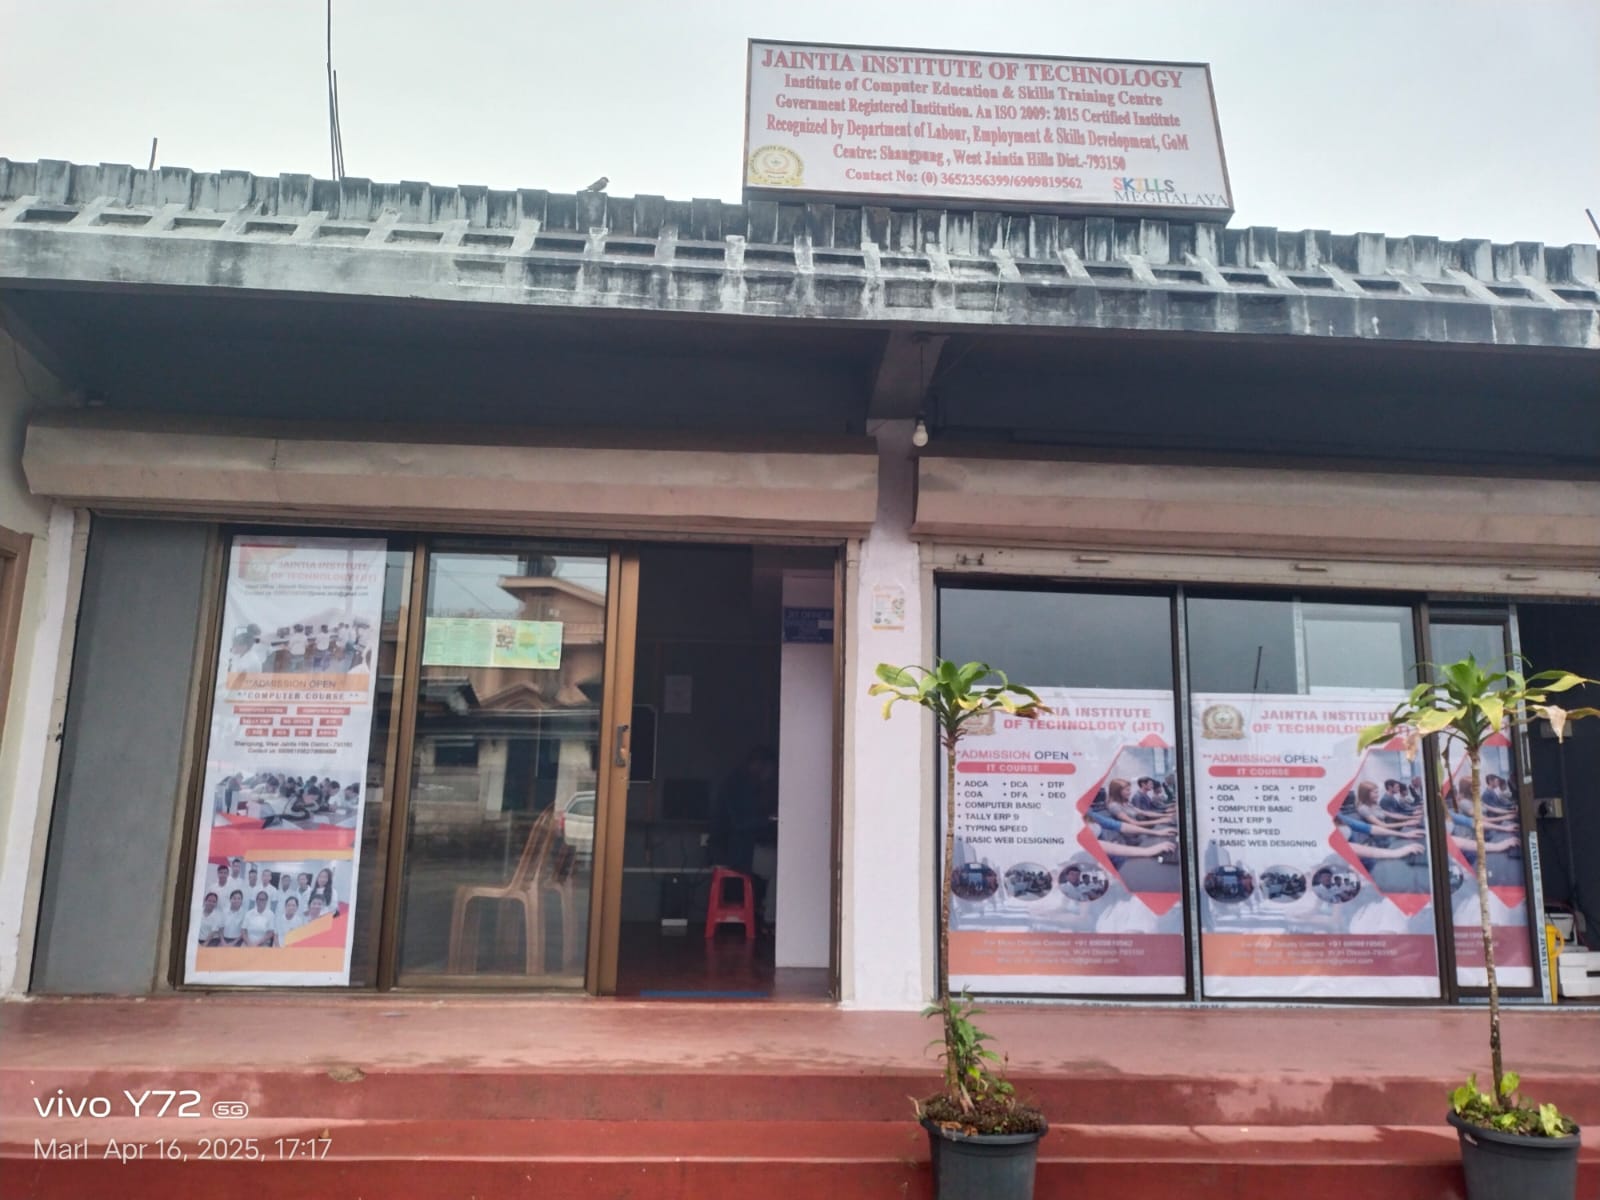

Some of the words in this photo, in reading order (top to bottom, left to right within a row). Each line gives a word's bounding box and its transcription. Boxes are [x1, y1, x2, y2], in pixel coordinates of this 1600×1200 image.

[761, 49, 856, 72] JAINTIA
[861, 55, 983, 79] INSTITUTE
[988, 61, 1019, 81] OF
[1024, 63, 1183, 88] TECHNOLOGY
[784, 73, 842, 91] Institute
[845, 77, 859, 92] of
[861, 78, 929, 96] Computer
[932, 81, 999, 99] Education
[1002, 85, 1015, 99] &
[1018, 86, 1055, 100] Skills
[1057, 86, 1116, 107] Training
[1118, 91, 1164, 106] Centre
[776, 93, 846, 112] Government
[848, 98, 909, 117] Registered
[911, 99, 973, 118] Institution.
[976, 104, 992, 119] An
[995, 105, 1018, 120] ISO
[1053, 107, 1080, 122] 2015
[1082, 109, 1132, 125] Certified
[1133, 111, 1181, 127] Institute
[767, 113, 828, 137] Recognized
[830, 118, 844, 140] by
[847, 119, 911, 141] Department
[914, 121, 926, 138] of
[927, 122, 971, 144] Labour,
[973, 125, 1041, 147] Employment
[1043, 127, 1054, 144] &
[1056, 127, 1086, 145] Skills
[1088, 129, 1161, 152] Development,
[1162, 134, 1190, 151] GoM
[833, 143, 878, 160] Centre:
[953, 148, 982, 166] West
[985, 150, 1024, 167] Jaintia
[1026, 151, 1055, 167] Hills
[845, 168, 893, 182] Contact
[896, 170, 918, 183] No:
[1112, 176, 1176, 193] SKILLS
[1114, 190, 1229, 207] MEGHALAYA
[1075, 706, 1152, 719] INSTITUTE
[1260, 710, 1319, 721] JAINTIA
[1003, 719, 1024, 730] OF
[1027, 719, 1127, 732] TECHNOLOGY
[1131, 721, 1166, 734] (JIT)
[1252, 723, 1274, 734] OF
[1034, 751, 1070, 761] OPEN
[1283, 754, 1320, 764] OPEN
[986, 764, 997, 773] IT
[1000, 764, 1041, 774] COURSE
[1236, 767, 1247, 776] IT
[1249, 767, 1291, 777] COURSE
[964, 780, 989, 788] ADCA
[1010, 780, 1029, 789] DCA
[1047, 781, 1065, 790] DTP
[1216, 784, 1240, 792] ADCA
[1261, 784, 1280, 792] DCA
[1298, 784, 1316, 792] DTP
[1010, 791, 1029, 799] DFA
[1262, 794, 1280, 802] DFA
[965, 801, 1014, 810] COMPUTER
[1016, 802, 1042, 810] BASIC
[1217, 804, 1266, 813] COMPUTER
[1267, 805, 1293, 813] BASIC
[965, 812, 992, 822] TALLY
[994, 813, 1012, 822] ERP
[1218, 816, 1244, 824] TALLY
[1246, 816, 1265, 825] ERP
[965, 824, 998, 833] TYPING
[1000, 824, 1028, 834] SPEED
[1218, 828, 1250, 836] TYPING
[1252, 828, 1281, 836] SPEED
[966, 836, 996, 845] BASIC
[997, 836, 1015, 845] WEB
[1017, 836, 1066, 846] DESIGNING
[1219, 839, 1247, 848] BASIC
[1247, 839, 1268, 848] WEB
[1269, 840, 1318, 849] DESIGNING
